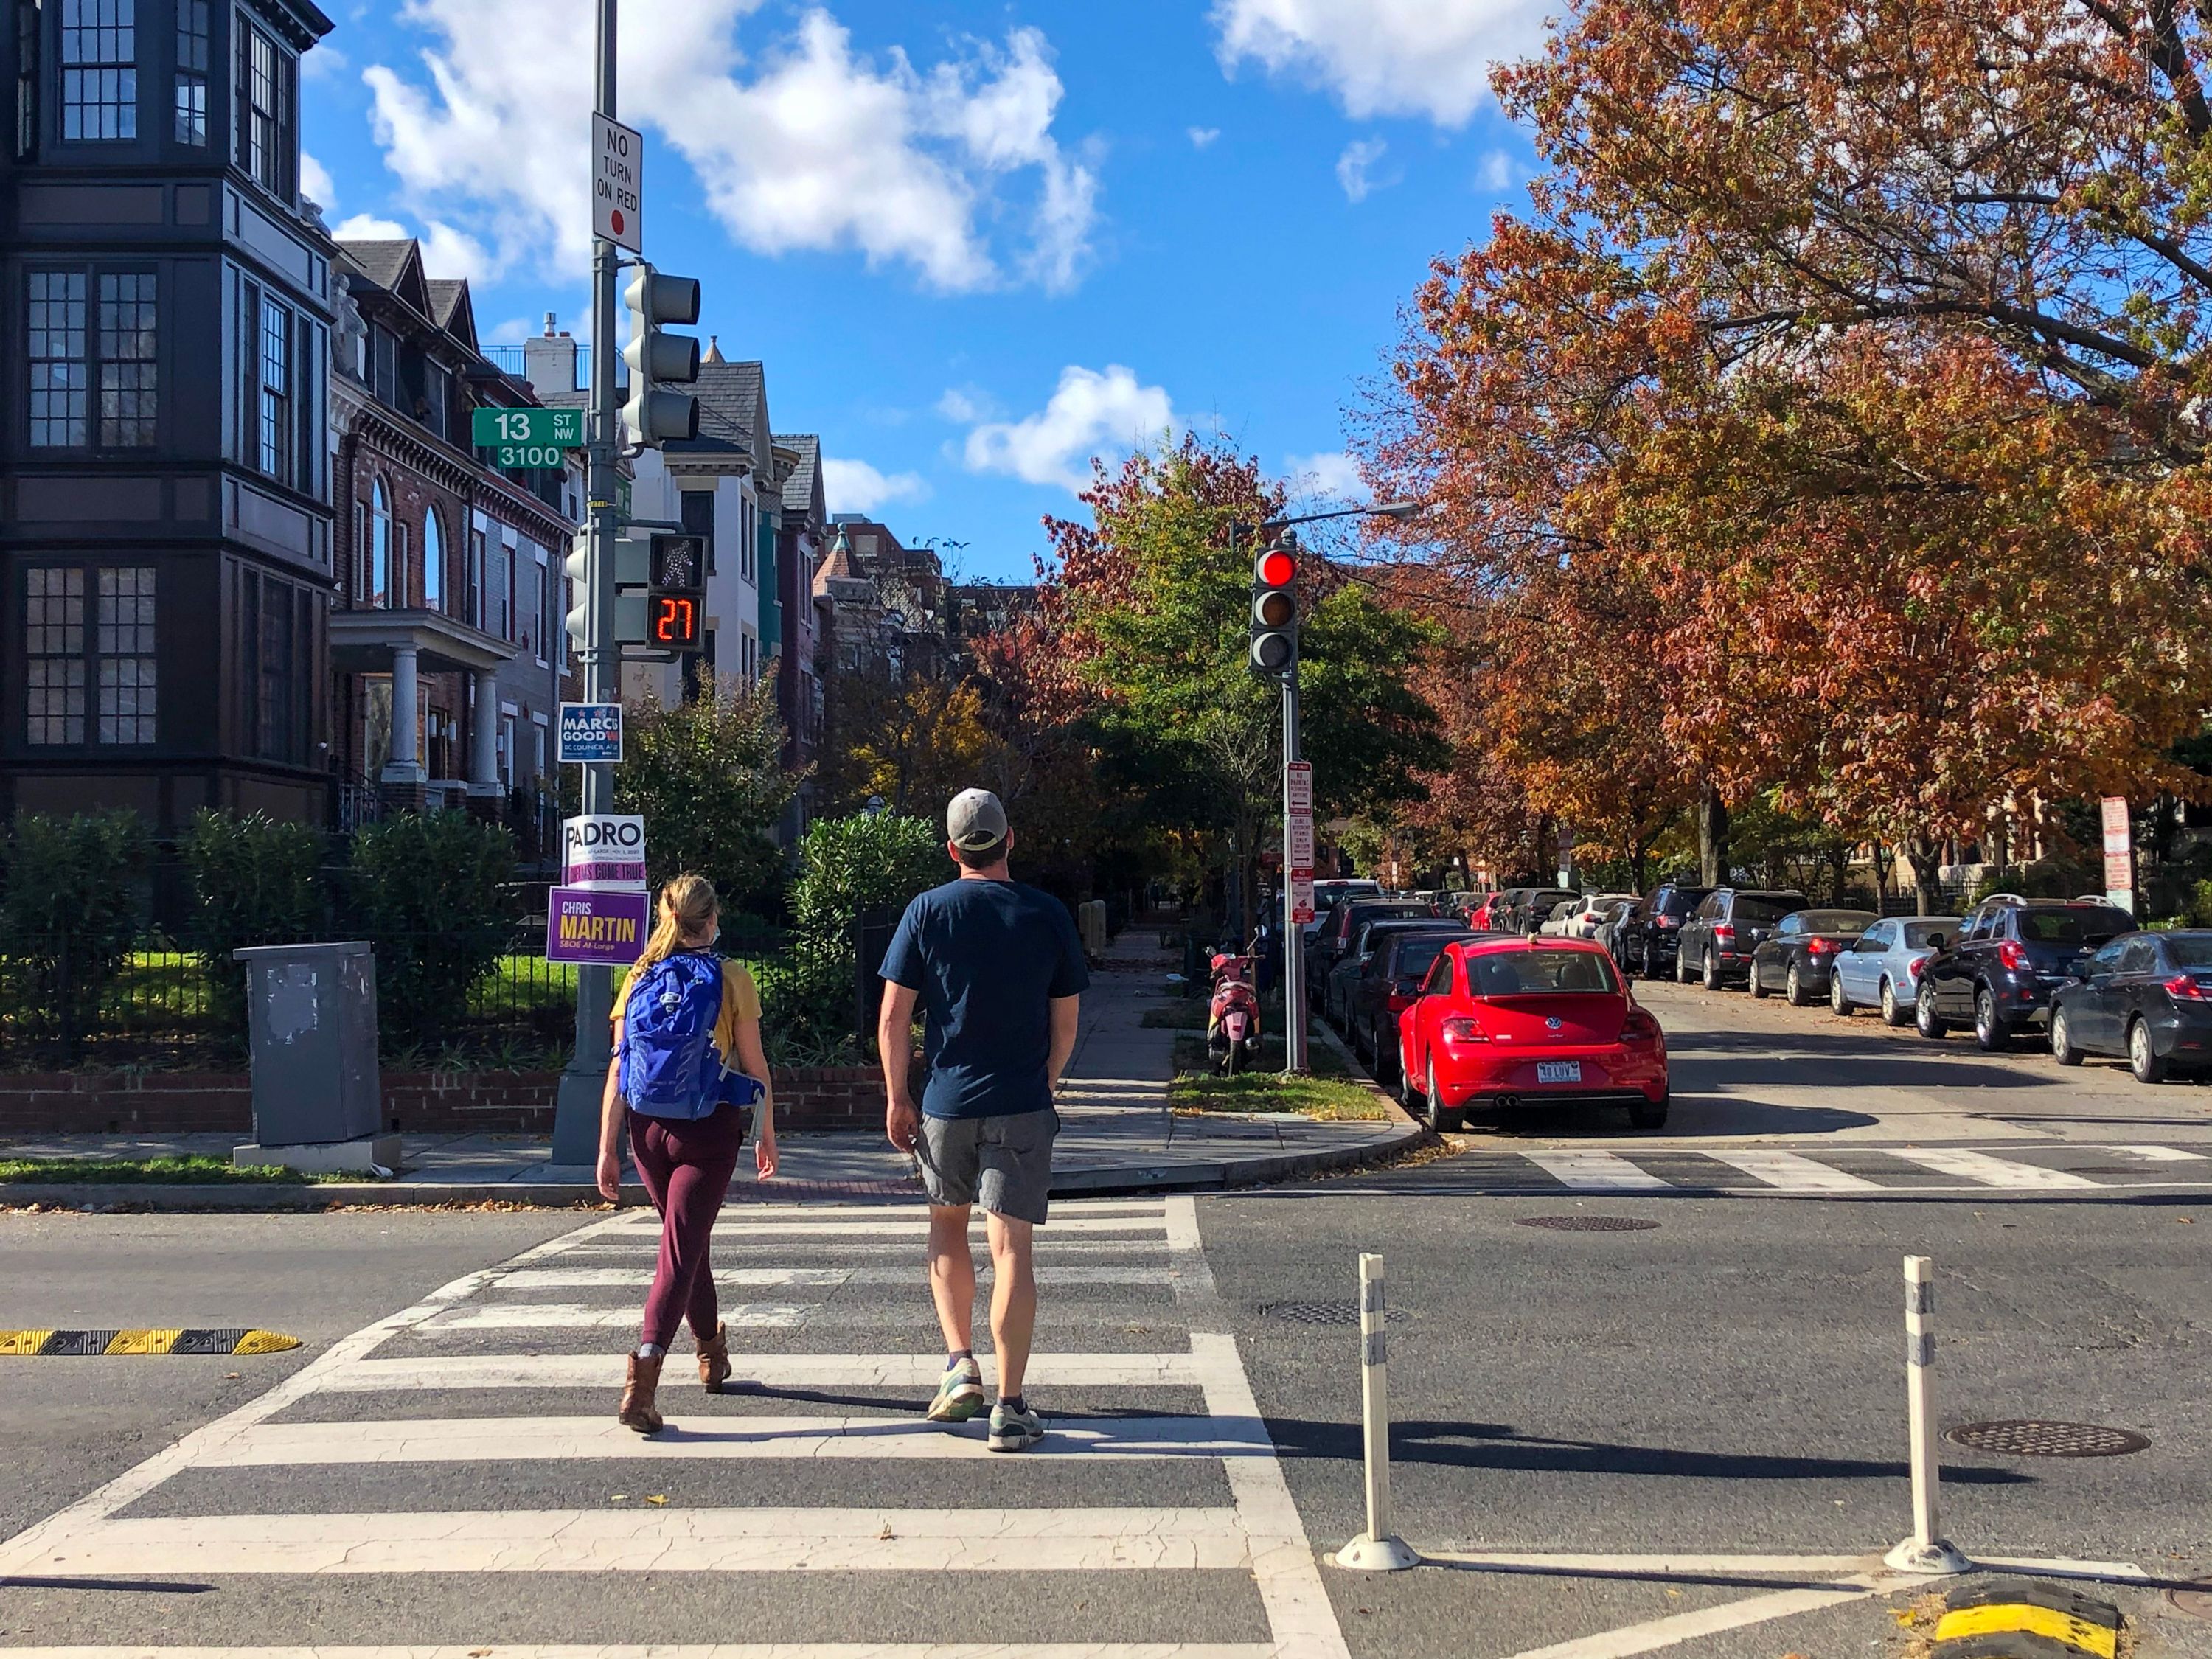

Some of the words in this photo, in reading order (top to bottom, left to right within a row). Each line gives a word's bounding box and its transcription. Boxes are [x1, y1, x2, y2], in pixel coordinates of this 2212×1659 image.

[607, 128, 628, 157] NO
[603, 155, 632, 185] TURN
[597, 178, 612, 201] ON
[617, 187, 637, 212] RED
[494, 413, 531, 441] 13
[554, 414, 572, 426] ST
[554, 428, 574, 440] NW
[501, 447, 560, 465] 3100
[658, 599, 692, 640] 27
[566, 821, 641, 849] PADRO
[595, 864, 619, 880] COME
[622, 863, 643, 880] TRUE
[562, 901, 591, 915] CHRIS
[560, 914, 636, 942] MARTIN
